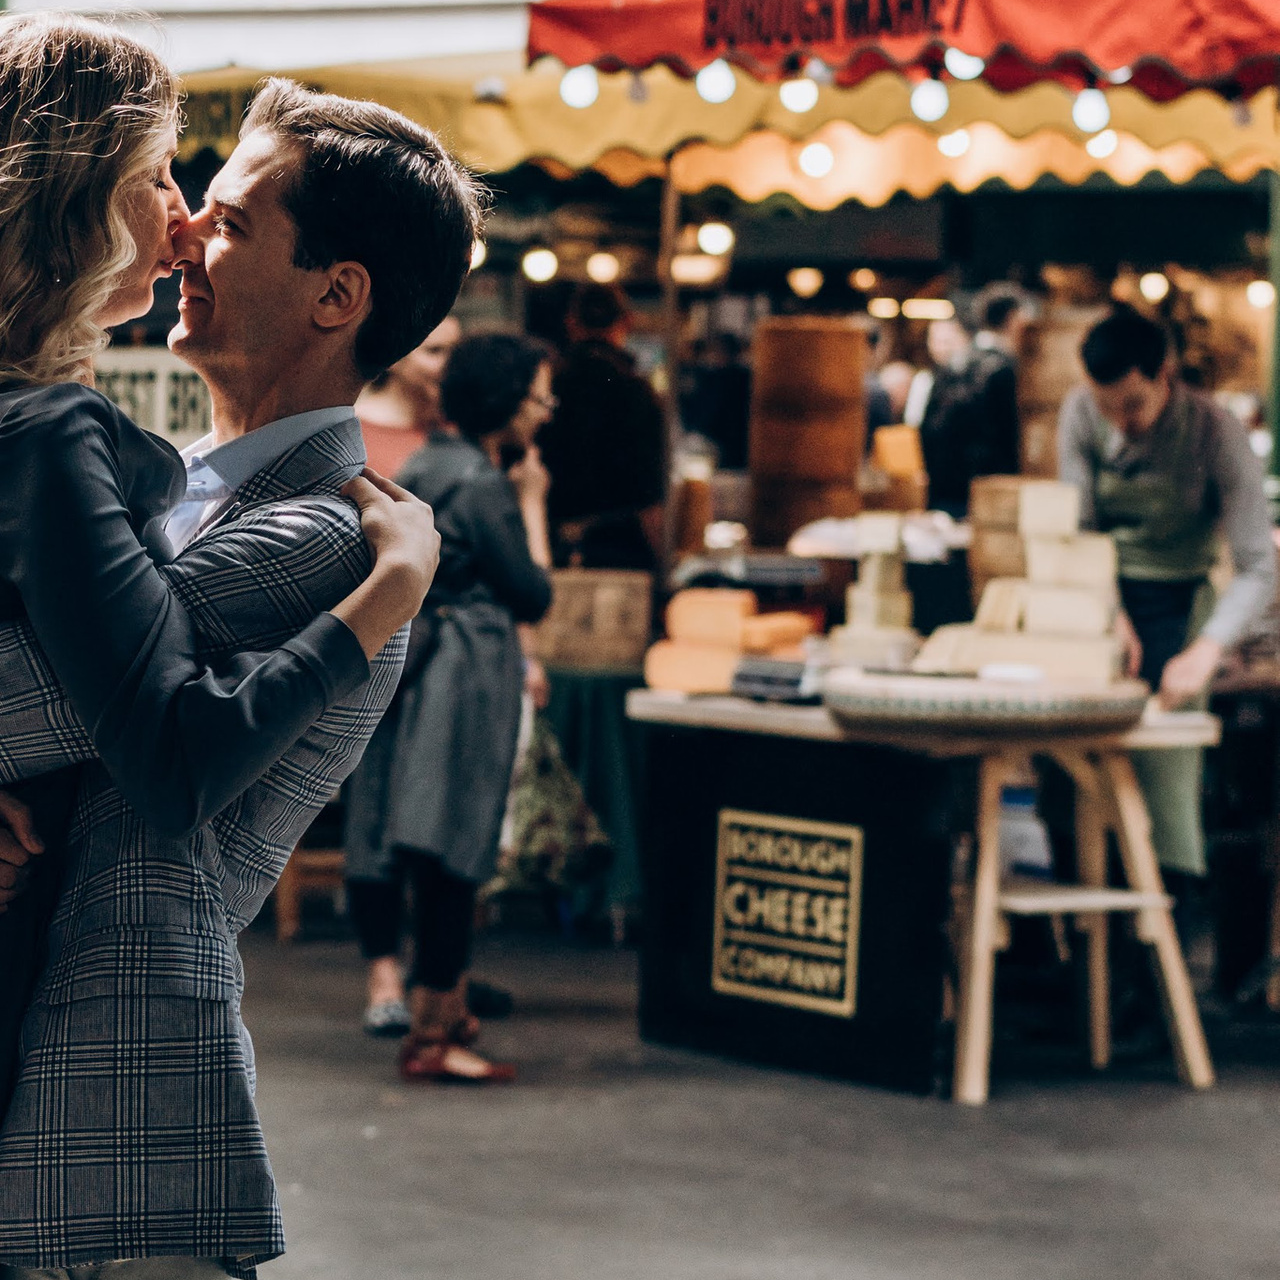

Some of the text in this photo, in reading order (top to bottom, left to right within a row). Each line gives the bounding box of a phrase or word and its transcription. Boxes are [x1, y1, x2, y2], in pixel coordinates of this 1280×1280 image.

[725, 829, 851, 875] BOROUGH
[723, 881, 847, 944] CHEESE
[721, 944, 842, 995] COMPANY
